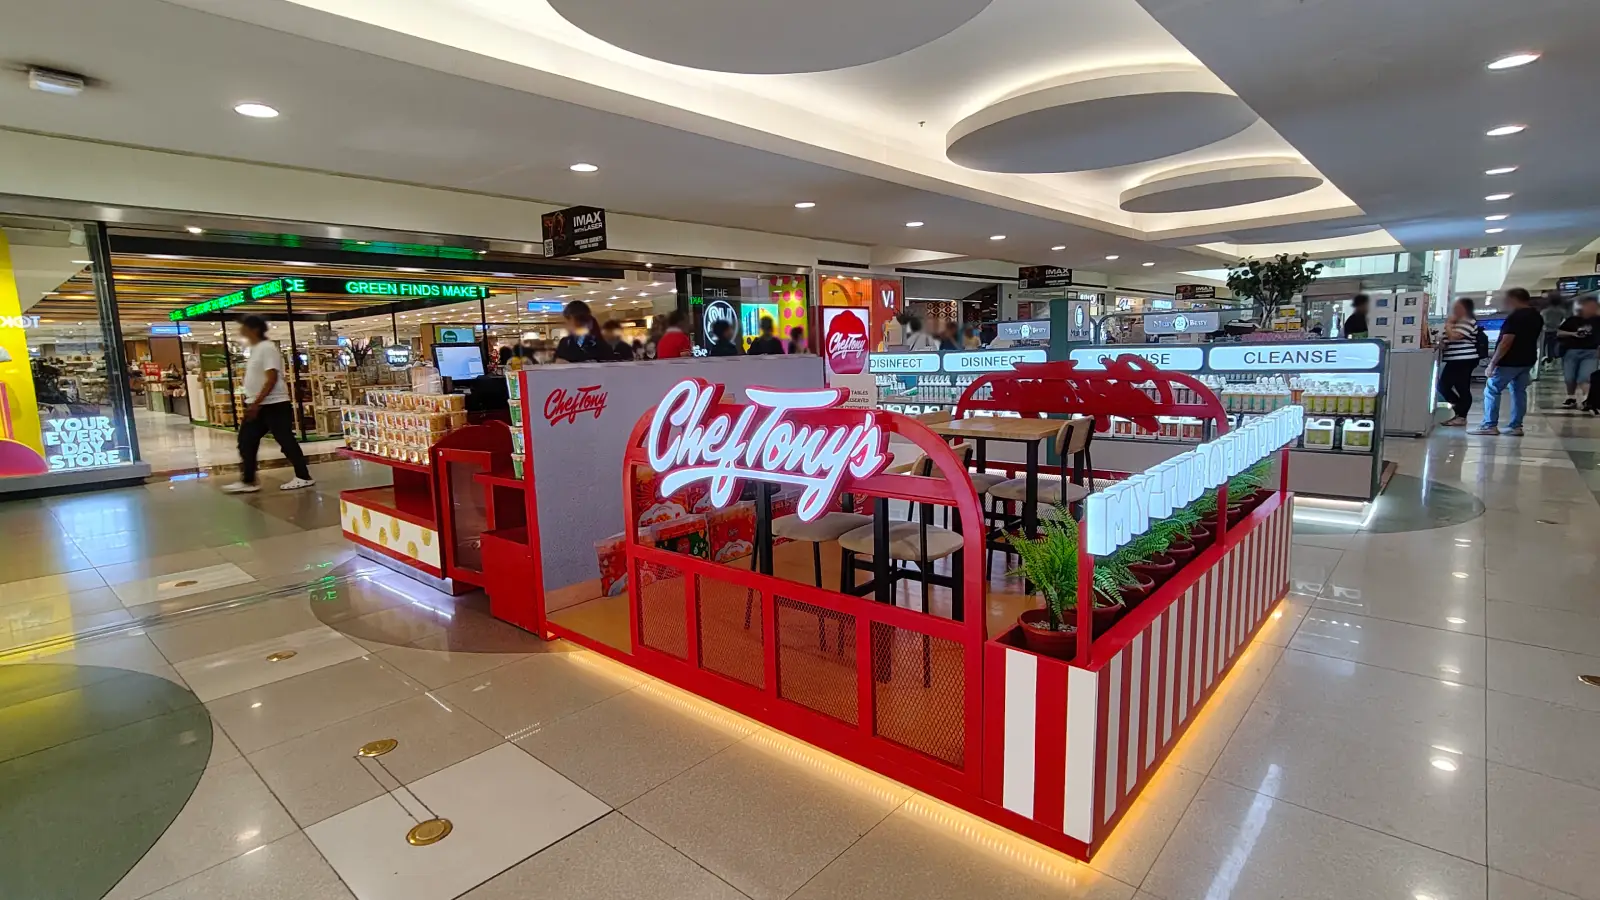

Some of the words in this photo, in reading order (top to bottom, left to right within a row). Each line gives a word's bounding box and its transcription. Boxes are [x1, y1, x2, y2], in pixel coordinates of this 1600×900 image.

[573, 211, 601, 227] IMAX
[585, 222, 603, 231] LASER
[345, 281, 397, 294] GREEN
[400, 283, 440, 295] FINDS
[443, 285, 477, 297] MAKE
[713, 288, 728, 298] THE
[870, 358, 923, 369] DISINFECT
[961, 355, 1026, 367] DISINFECT
[1243, 350, 1337, 364] CLEANSE
[48, 416, 110, 432] YOUR
[45, 427, 115, 446] EVERY
[61, 440, 105, 456] DAY
[49, 449, 121, 468] STORE
